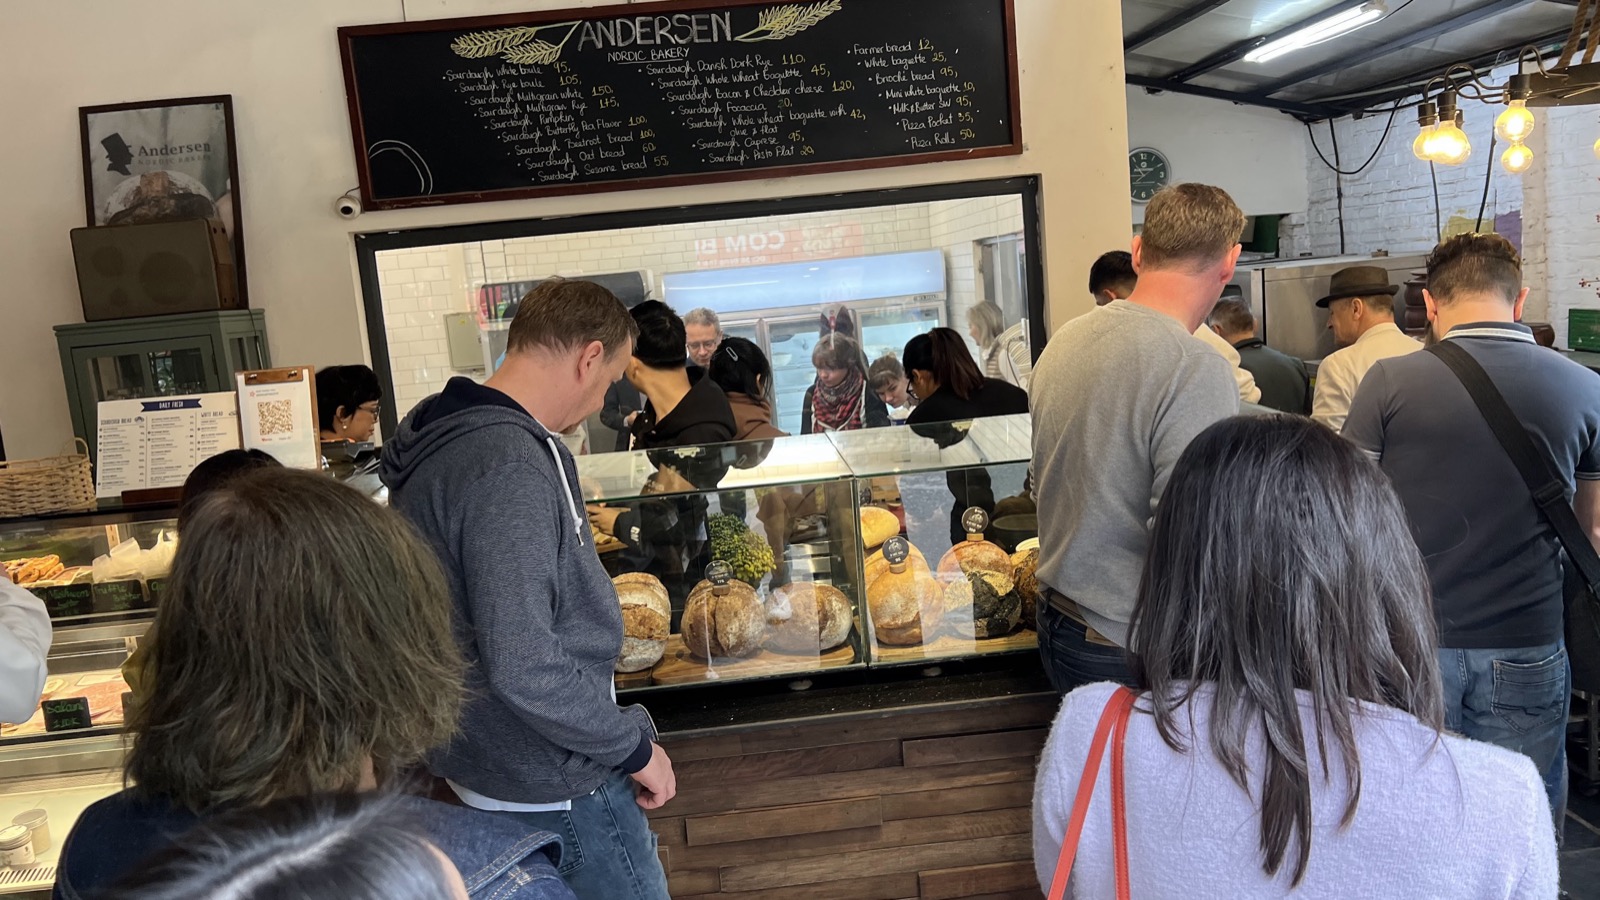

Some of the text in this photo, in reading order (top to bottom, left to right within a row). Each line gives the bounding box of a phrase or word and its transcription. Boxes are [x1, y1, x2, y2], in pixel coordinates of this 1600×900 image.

[578, 12, 732, 51] ANDERSEN
[608, 47, 689, 62] NORDIC BAKERY
[853, 43, 884, 55] Farmer
[646, 61, 695, 78] Sourdough
[730, 54, 754, 69] Dark
[755, 54, 773, 71] Rye
[891, 53, 927, 70] baguette
[446, 67, 493, 84] Sourdough
[658, 74, 702, 92] Sourdough
[911, 69, 936, 81] bread
[459, 80, 499, 94] Sourdough
[502, 79, 518, 94] Rye
[667, 87, 711, 105] Sourdough
[753, 83, 791, 97] Cheddar
[925, 83, 961, 100] baguette
[470, 92, 514, 108] Sourdough
[478, 103, 522, 119] Sourdough
[572, 100, 588, 116] Rye
[679, 102, 721, 119] Sourdough
[727, 101, 766, 112] Focaccia
[687, 115, 727, 133] Sourdough
[829, 104, 847, 117] with
[490, 111, 574, 132] Sourdough Pumpkin
[901, 118, 926, 131] Pizza
[927, 113, 953, 128] Pocket
[502, 127, 542, 146] Sourdough
[545, 122, 580, 139] Butterfly
[911, 136, 932, 149] Pizza
[138, 143, 211, 156] Andersen
[515, 139, 560, 161] Sourdough
[565, 135, 601, 149] Beetroot
[697, 136, 740, 154] Sourdough
[744, 137, 780, 150] Caprese
[525, 152, 574, 171] Sourdough
[579, 149, 595, 161] Oat
[709, 150, 749, 165] Sourdough
[754, 149, 773, 160] Pesto
[776, 145, 794, 157] Flat
[538, 164, 579, 181] Sourdough
[584, 163, 617, 174] Sesame
